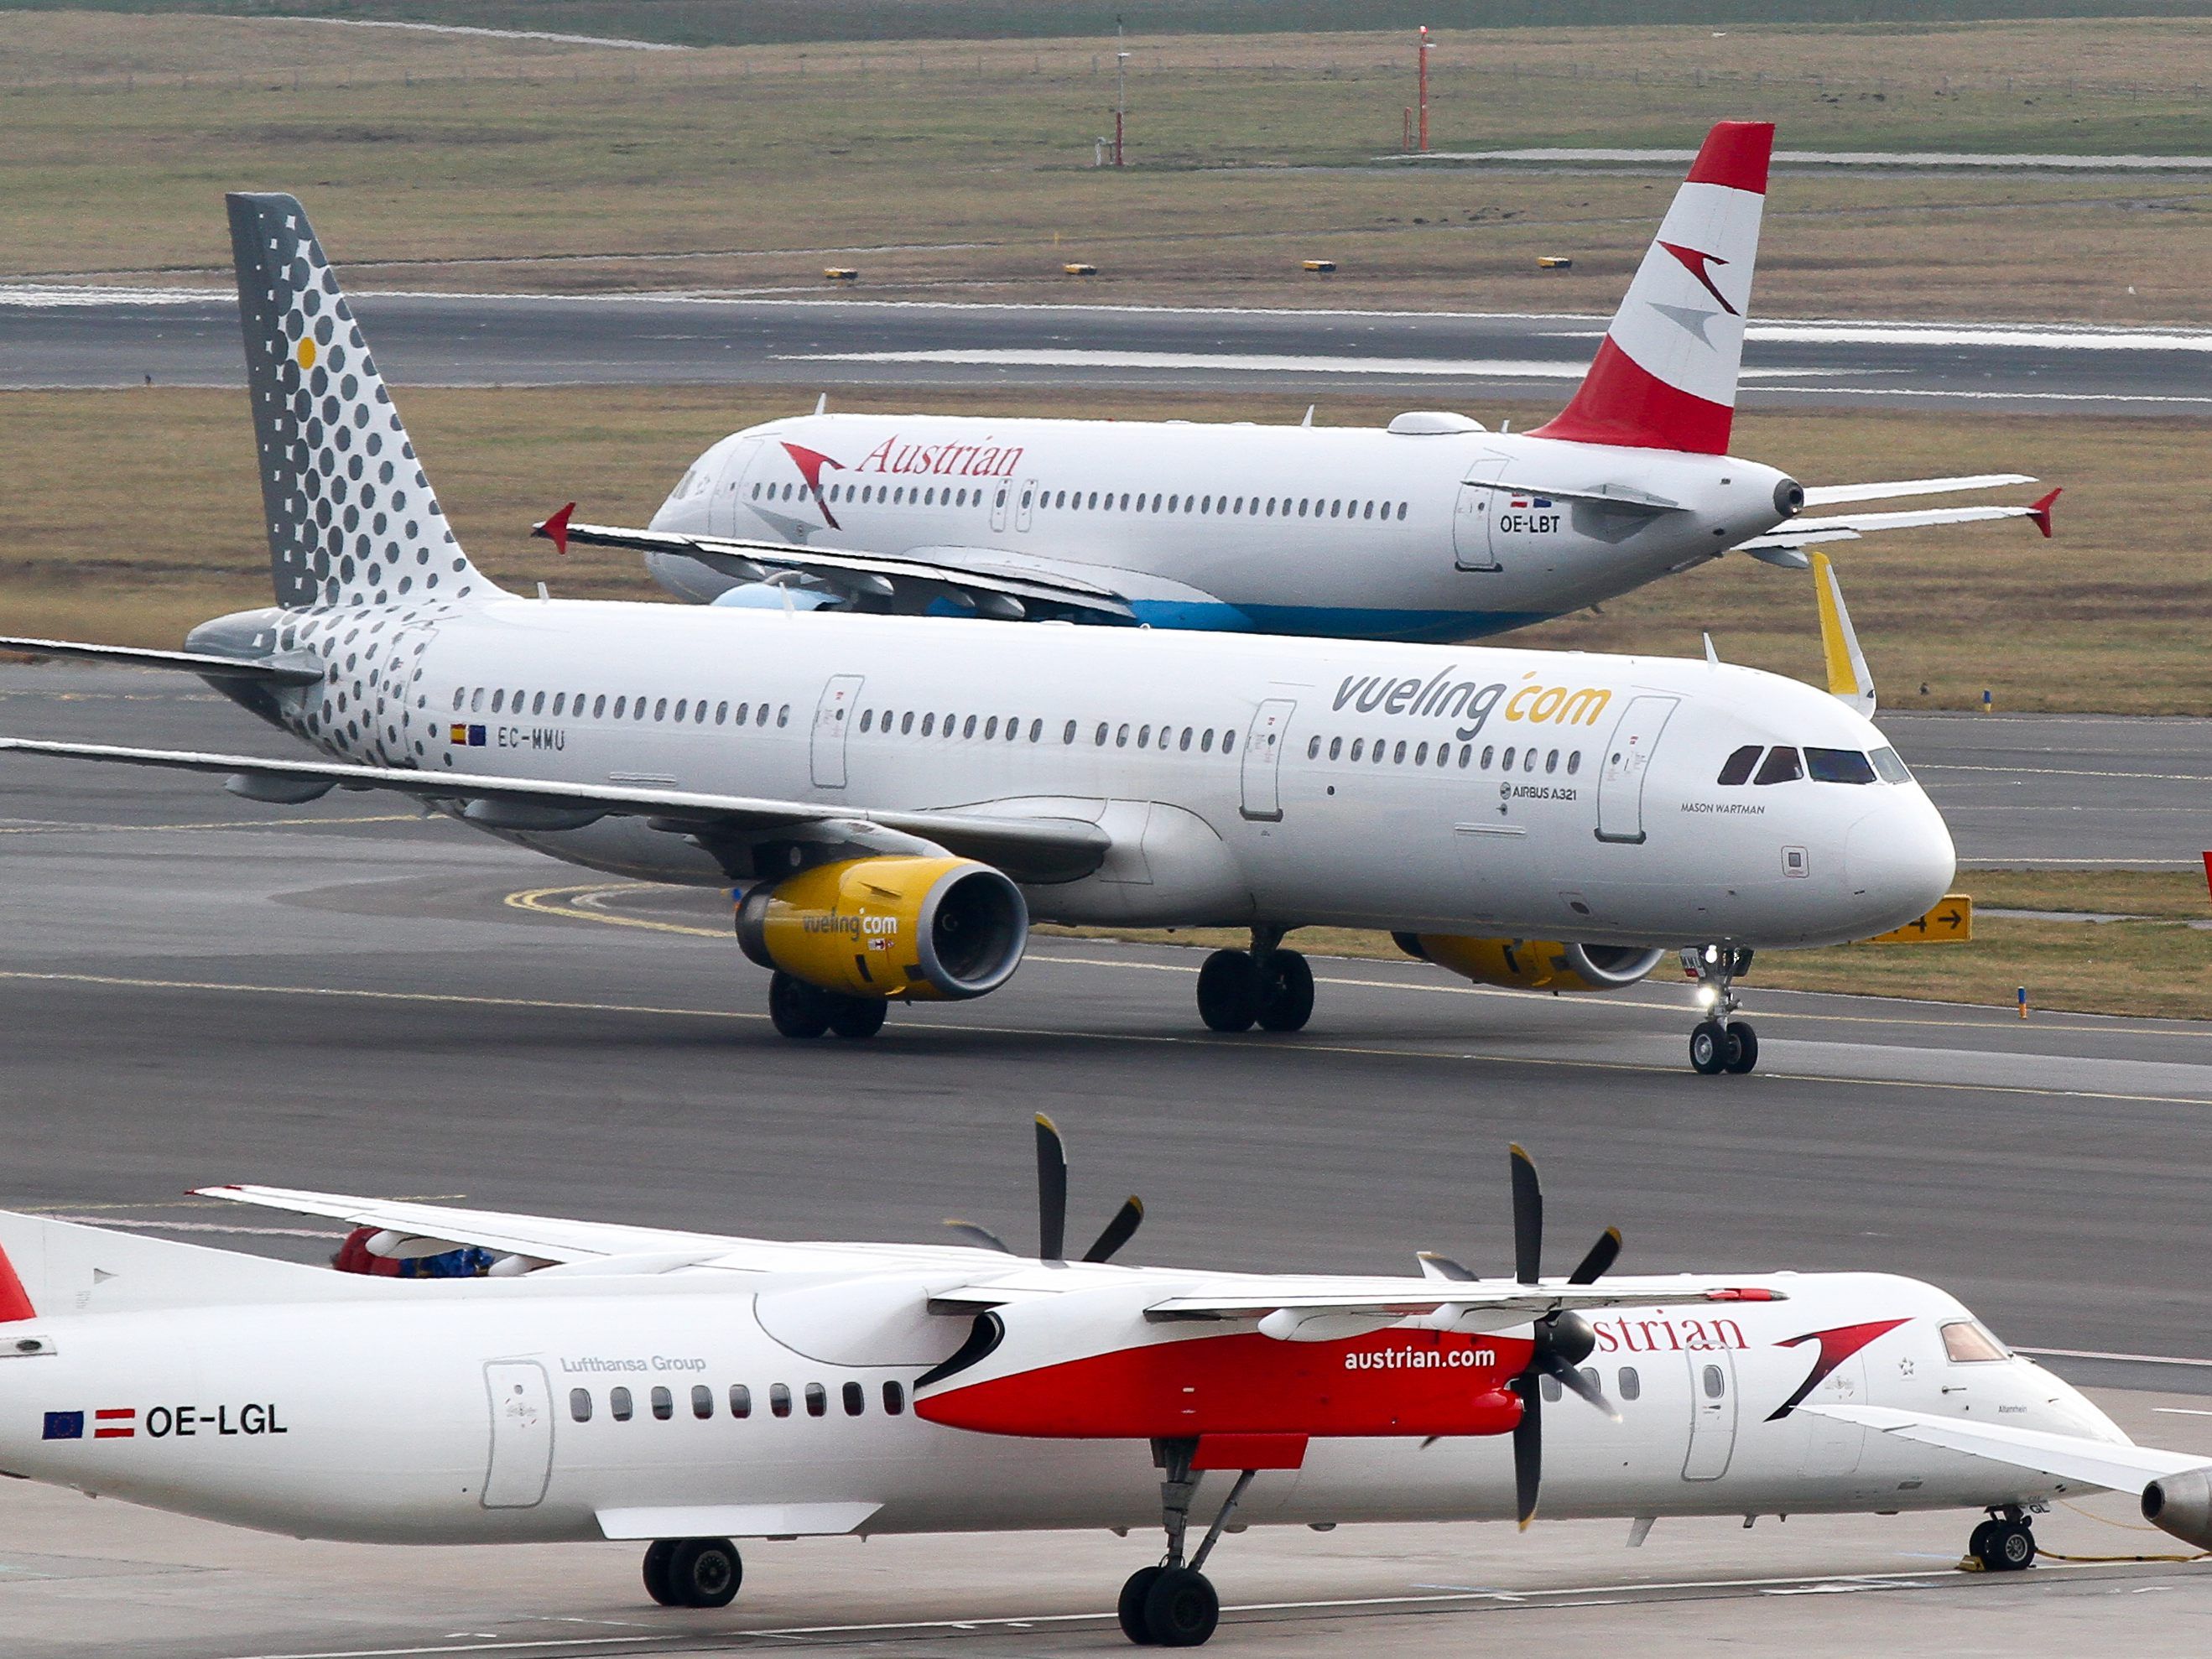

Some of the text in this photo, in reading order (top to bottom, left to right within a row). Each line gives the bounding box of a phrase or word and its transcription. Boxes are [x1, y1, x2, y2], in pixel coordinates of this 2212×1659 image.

[854, 433, 1024, 476] Austrian
[1501, 515, 1560, 533] OE-LBT
[497, 726, 565, 751] EC-MMU
[1512, 786, 1577, 800] AIRBUS A321
[1680, 803, 1766, 814] MASON WARTMAN
[1592, 1309, 1751, 1353] strian
[560, 1355, 706, 1373] Lufthansa Group
[1345, 1345, 1496, 1370] austrian.com
[146, 1403, 288, 1438] OE-LGL
